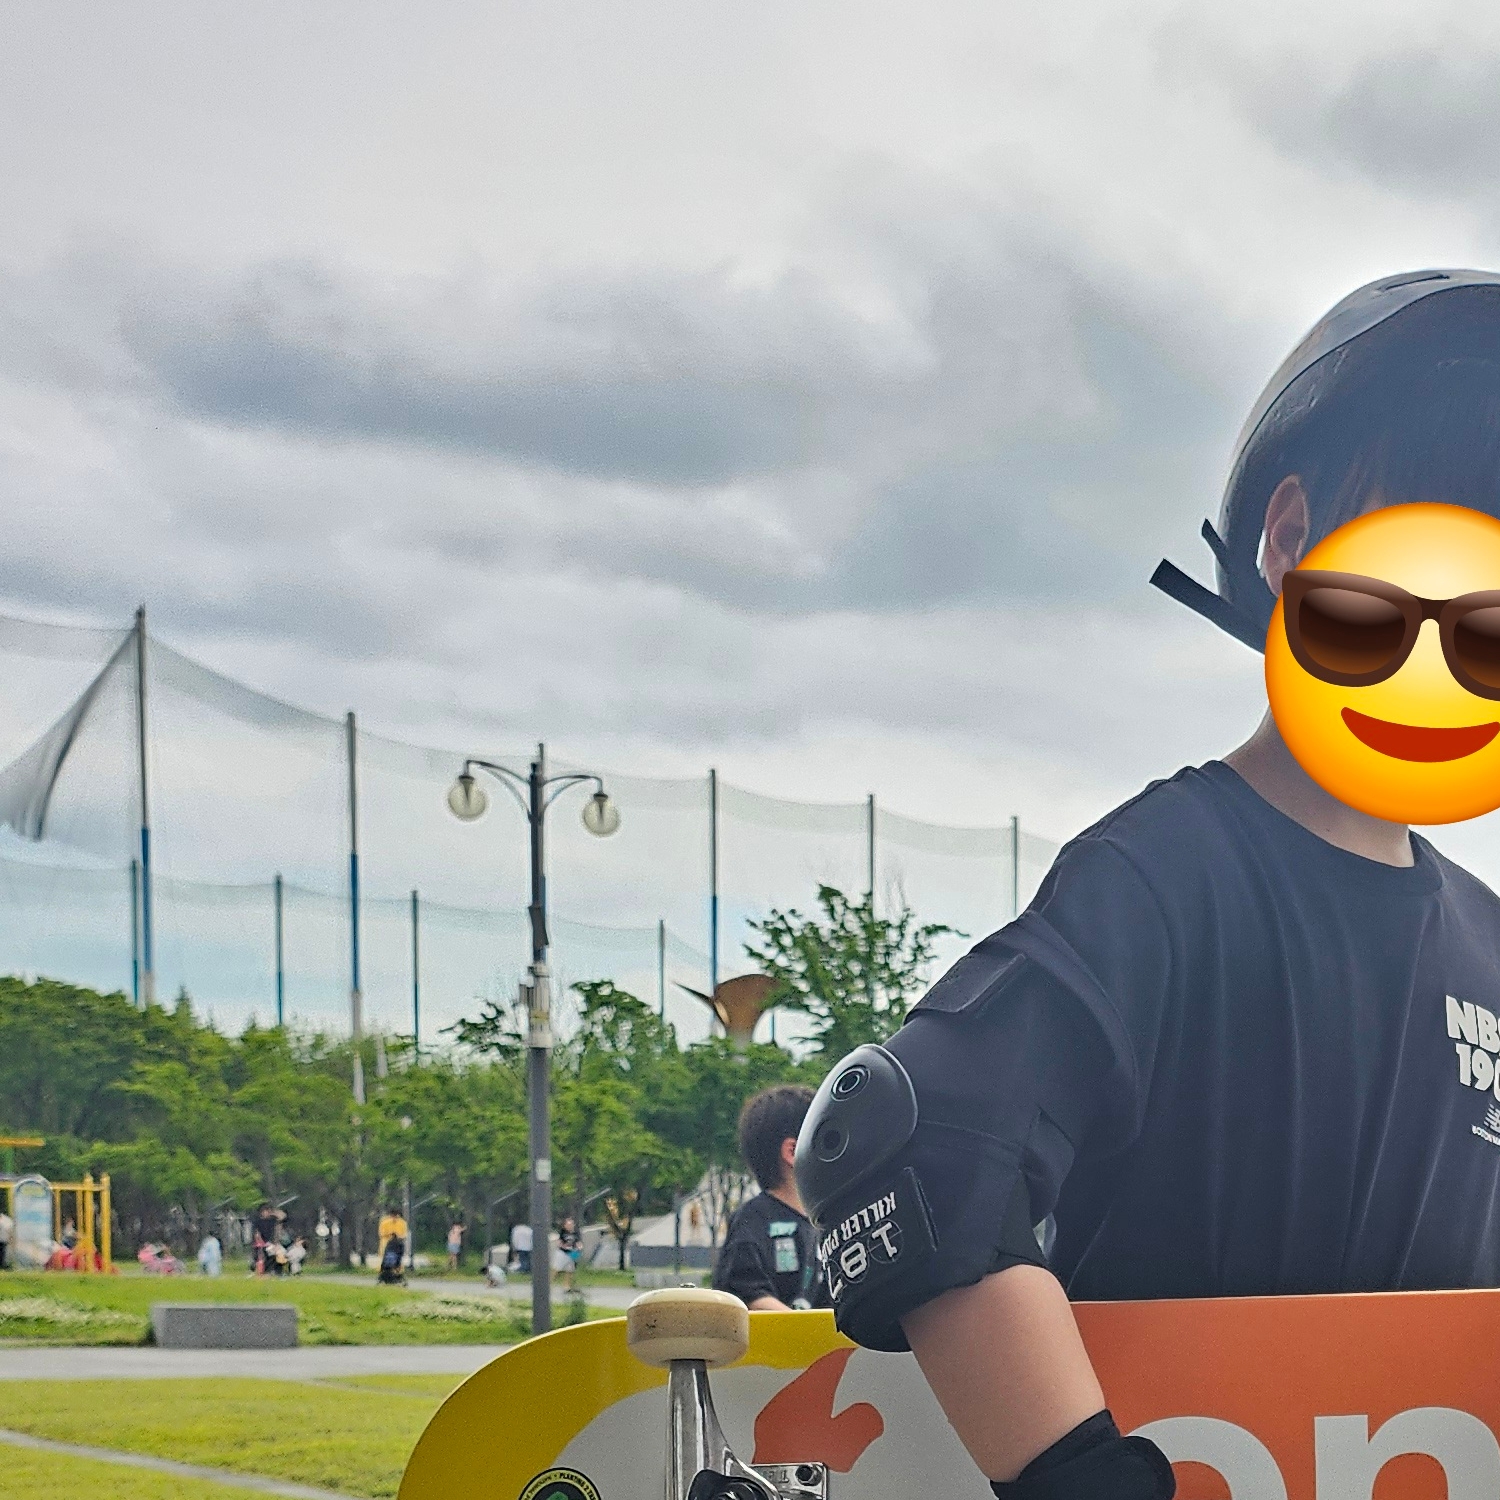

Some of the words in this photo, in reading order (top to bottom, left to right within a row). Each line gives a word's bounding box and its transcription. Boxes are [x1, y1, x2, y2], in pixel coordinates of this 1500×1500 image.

[841, 1192, 896, 1242] KILLER
[828, 1222, 898, 1301] 187
[582, 1483, 590, 1492] 2
